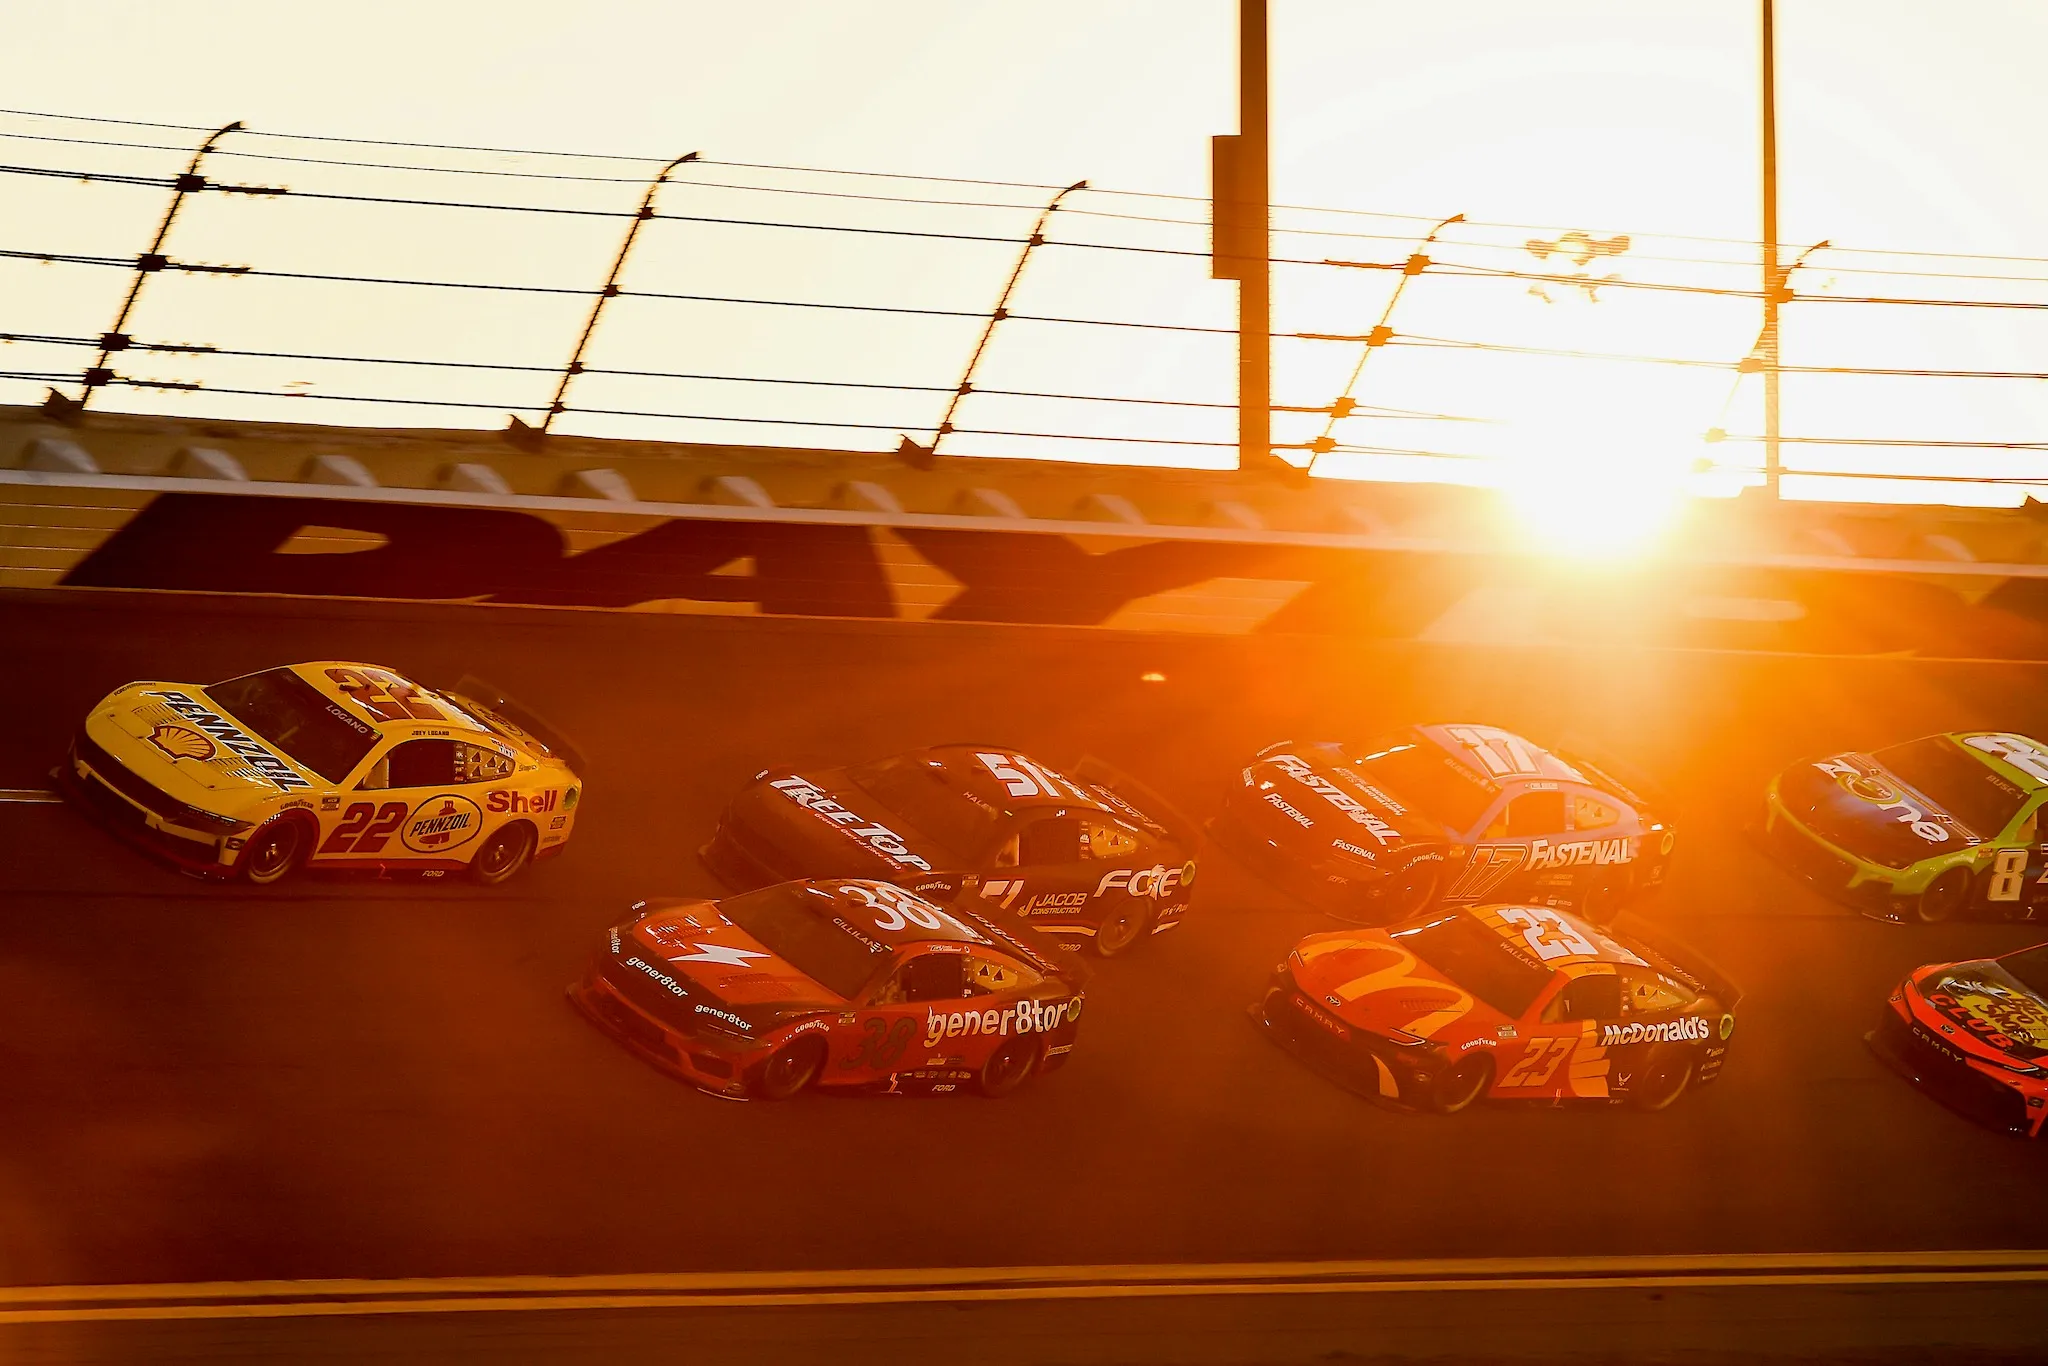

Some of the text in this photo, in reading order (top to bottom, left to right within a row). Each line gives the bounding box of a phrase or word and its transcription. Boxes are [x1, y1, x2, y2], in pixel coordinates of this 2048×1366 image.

[324, 668, 448, 723] 22
[325, 704, 367, 734] LOGANO
[140, 689, 313, 793] PENNZOIL
[1443, 727, 1543, 780] 17
[974, 752, 1062, 798] 51
[486, 790, 558, 813] Shell
[1261, 754, 1402, 846] FASTENAL
[1263, 793, 1315, 829] FASTENAL
[318, 803, 407, 854] 22
[409, 811, 472, 838] PENNZOIL
[769, 774, 933, 872] TREE TOP
[1332, 839, 1376, 861] FASTENAL
[1411, 851, 1445, 864] GOODYEAR
[1524, 837, 1634, 872] FASTENAL
[421, 870, 445, 878] FORD
[915, 880, 952, 891] GOODYEAR
[1443, 842, 1530, 903] 17
[1987, 848, 2029, 902] 8
[631, 900, 647, 911] FORD
[839, 885, 941, 931] 38
[1031, 907, 1082, 916] CONSTRUCTION
[1035, 892, 1088, 908] JACOB
[1495, 906, 1600, 961] 23
[1499, 941, 1541, 971] WALLACE
[625, 955, 689, 998] gener8tor
[695, 1003, 753, 1031] gener8tor
[794, 1020, 831, 1034] GOODYEAR
[923, 999, 1068, 1048] gener8tor
[1295, 997, 1345, 1036] CAMRY
[1600, 1016, 1711, 1047] McDonald's
[1928, 993, 2015, 1052] CLUB
[840, 1017, 919, 1070] 38
[1461, 1036, 1498, 1052] GOODYEAR
[1912, 1026, 1963, 1063] CAMRY
[1497, 1037, 1584, 1088] 23
[932, 1084, 956, 1092] FORD
